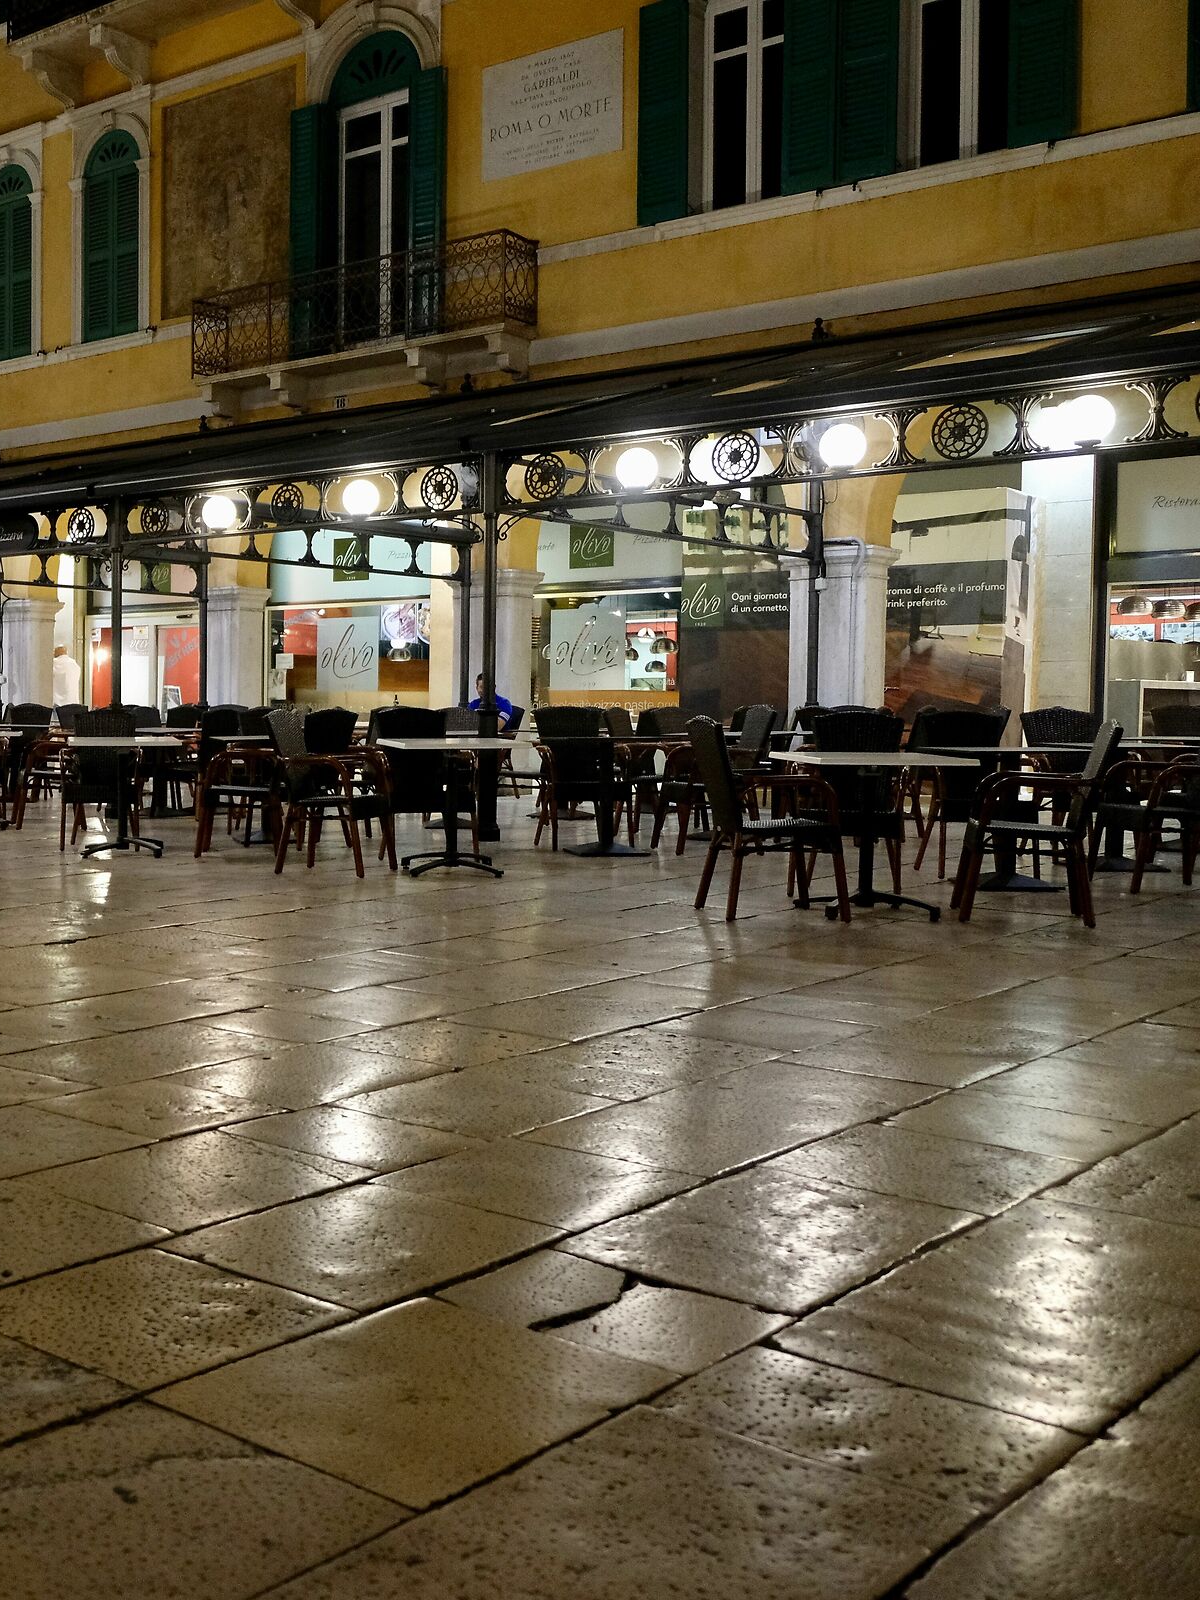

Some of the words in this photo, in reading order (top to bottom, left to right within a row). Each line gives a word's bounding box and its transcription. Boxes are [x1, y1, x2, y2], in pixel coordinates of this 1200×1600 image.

[523, 69, 579, 93] GARIBALDI
[490, 119, 533, 142] ROMA
[538, 113, 551, 129] O
[558, 97, 612, 123] MORTE
[1151, 495, 1200, 509] Ristora
[335, 540, 368, 575] oliv
[572, 527, 611, 561] olivo
[680, 582, 721, 620] olivo
[731, 592, 752, 603] Ogni
[753, 592, 788, 602] giornata
[913, 585, 922, 594] di
[924, 584, 948, 594] caffè
[958, 583, 964, 592] il
[965, 581, 1006, 593] profumo
[730, 604, 739, 613] di
[740, 605, 751, 613] un
[752, 604, 789, 613] cornetto.
[907, 598, 948, 609] preferito.
[321, 623, 374, 679] olivo
[555, 615, 619, 676] olivo
